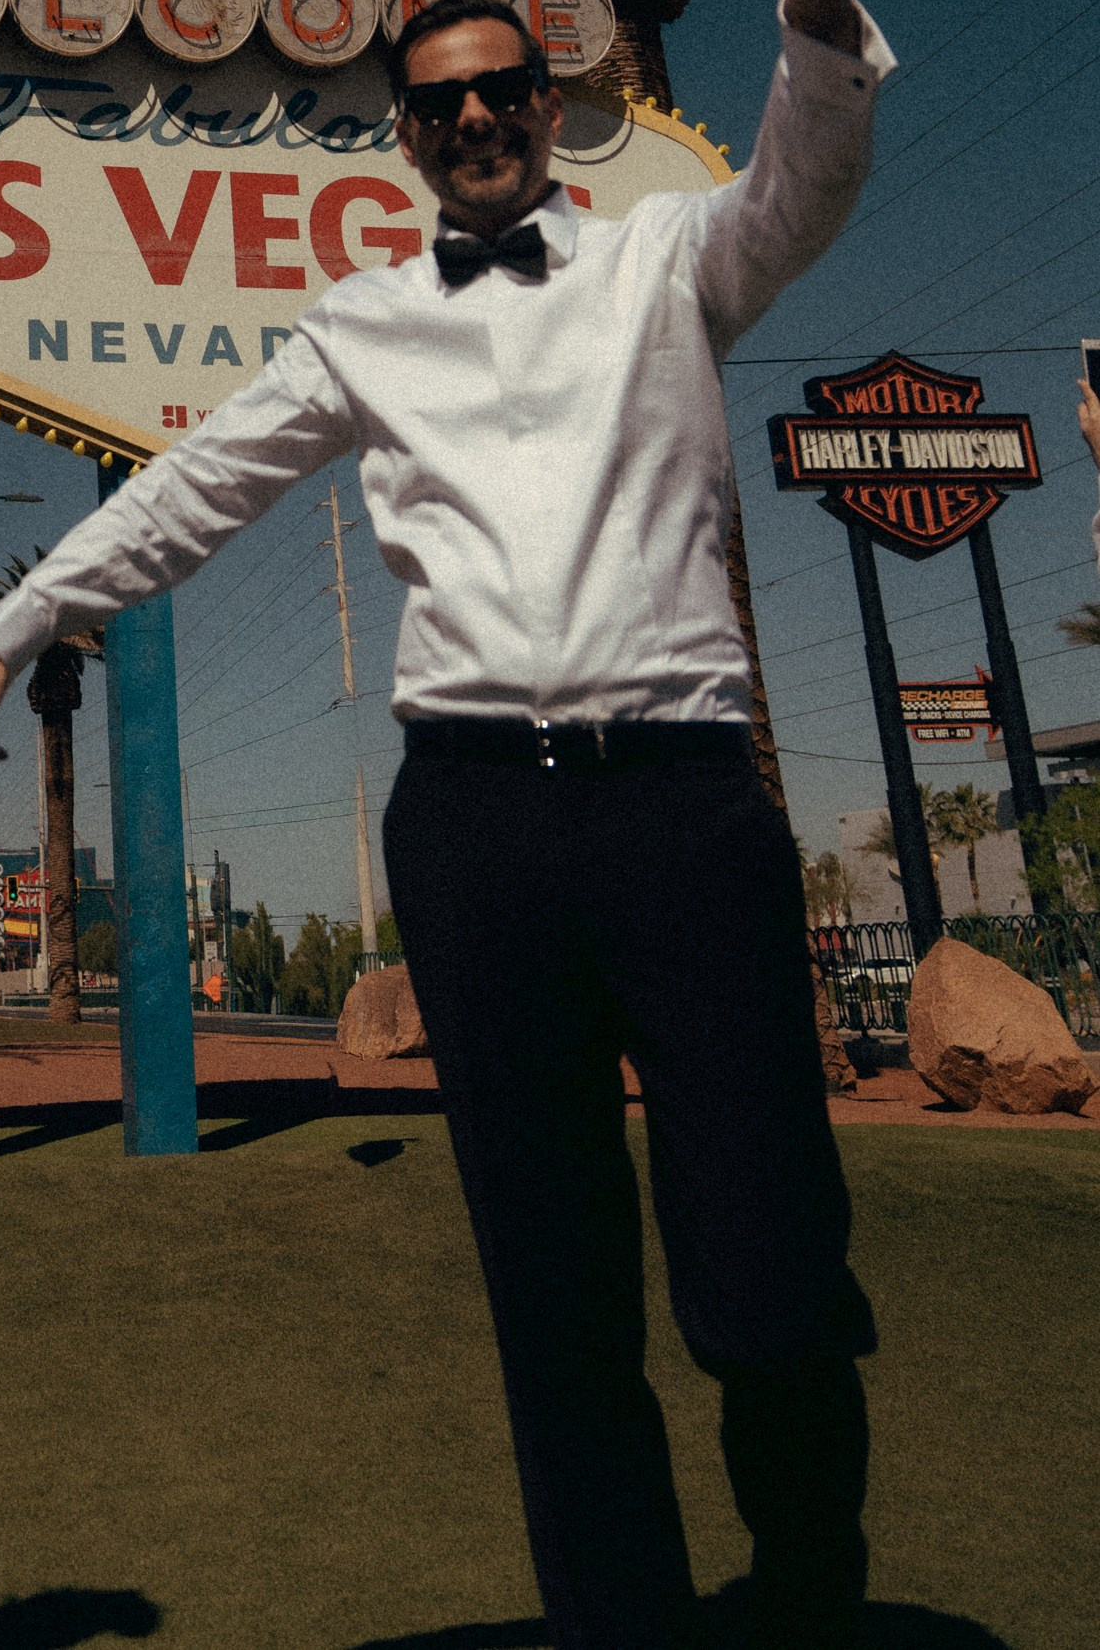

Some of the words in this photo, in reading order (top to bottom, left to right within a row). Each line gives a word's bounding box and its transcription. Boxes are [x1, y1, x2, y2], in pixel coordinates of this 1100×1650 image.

[102, 164, 592, 291] VEG
[27, 318, 295, 367] NEVAD
[843, 371, 965, 415] MOTOR
[798, 429, 1026, 469] HARLEY-DAVIDSON
[859, 484, 981, 536] CYCLES
[917, 729, 935, 739] FREE
[956, 729, 971, 738] ATM
